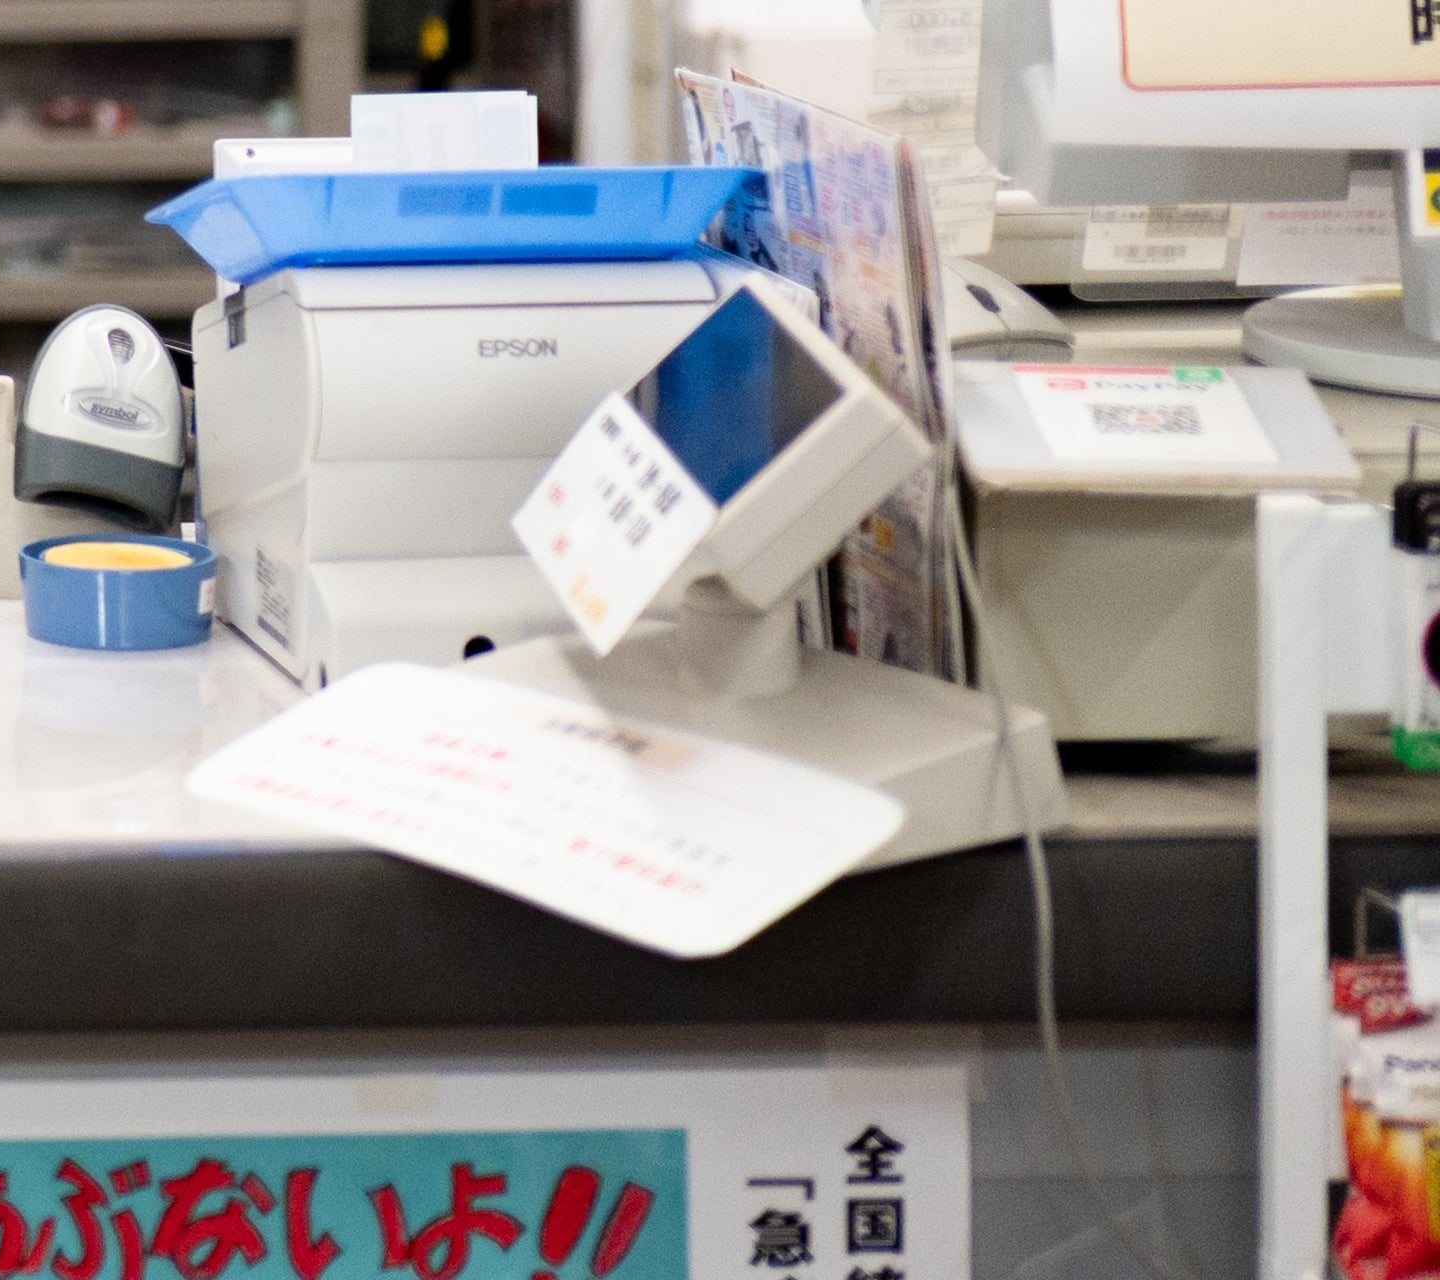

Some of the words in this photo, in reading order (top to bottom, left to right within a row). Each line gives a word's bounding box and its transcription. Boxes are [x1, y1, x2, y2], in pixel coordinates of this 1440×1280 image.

[479, 339, 557, 357] EPSON
[90, 403, 139, 424] symbol
[844, 1124, 906, 1280] 全国
